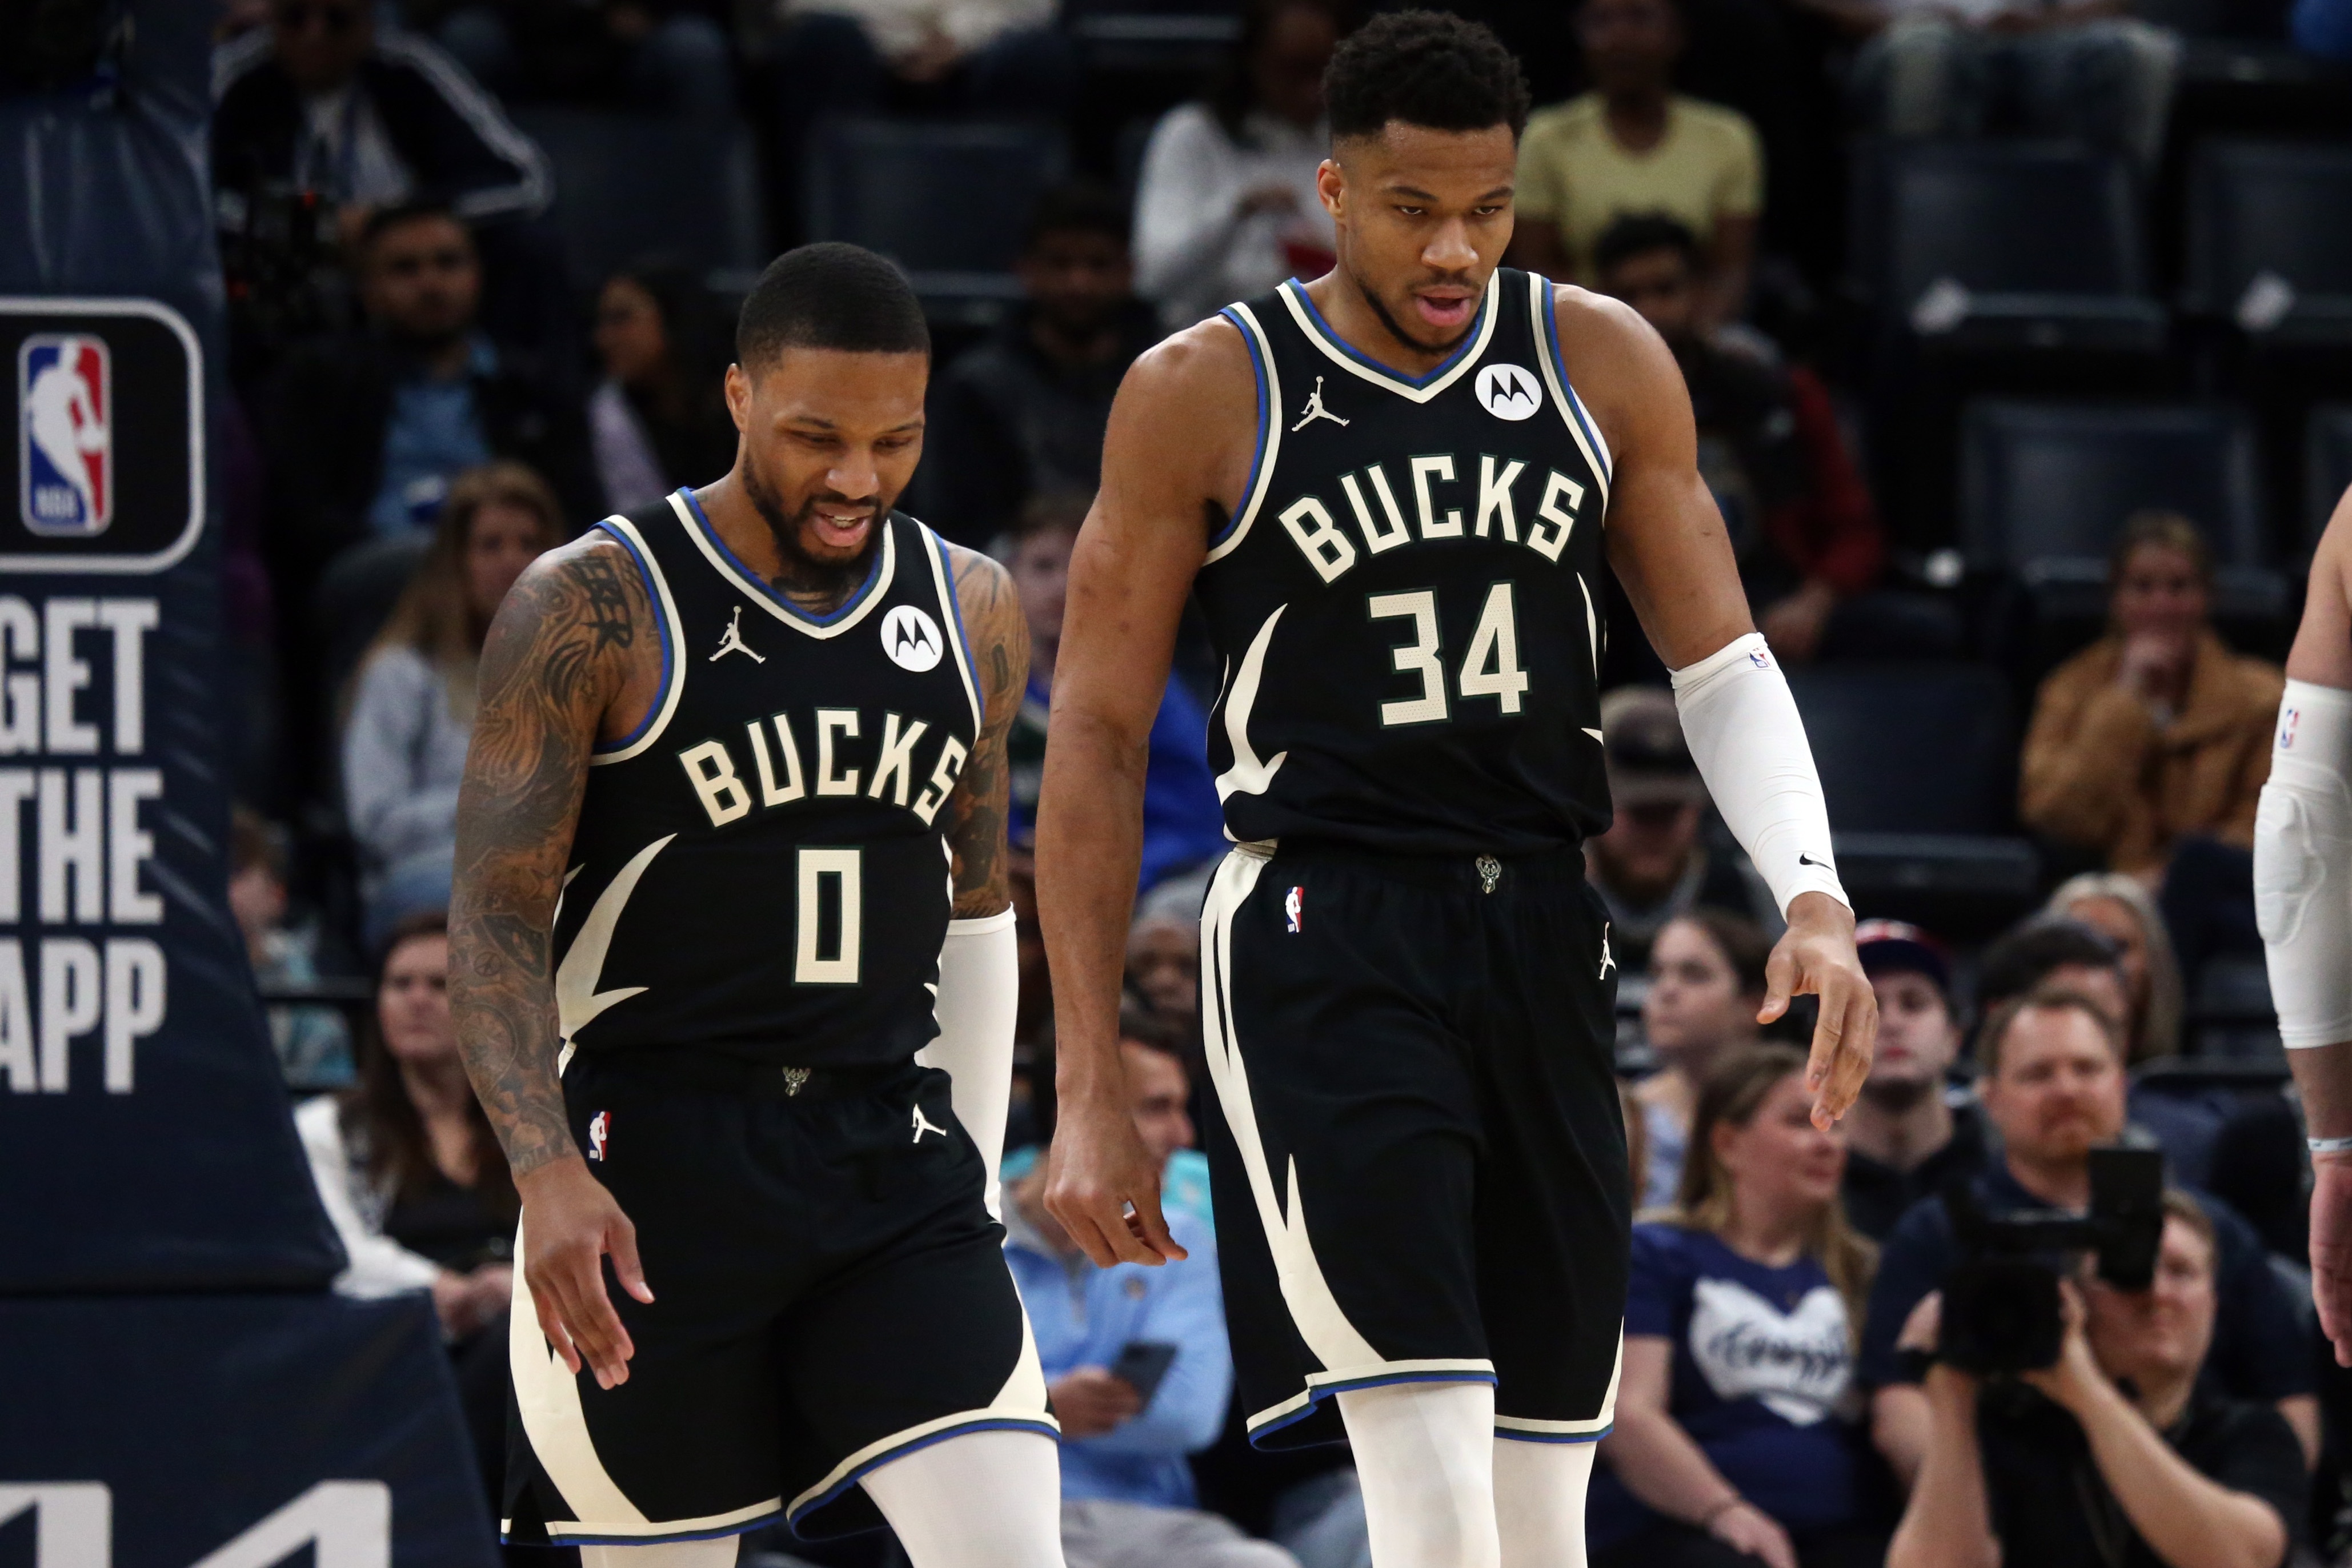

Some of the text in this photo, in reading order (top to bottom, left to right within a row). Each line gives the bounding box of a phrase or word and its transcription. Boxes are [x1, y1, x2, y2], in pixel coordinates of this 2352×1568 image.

[1276, 454, 1587, 585] BUCKS
[0, 597, 160, 755] GET
[1368, 580, 1531, 728] 34
[677, 707, 968, 829] BUCKS
[792, 847, 864, 986] 0
